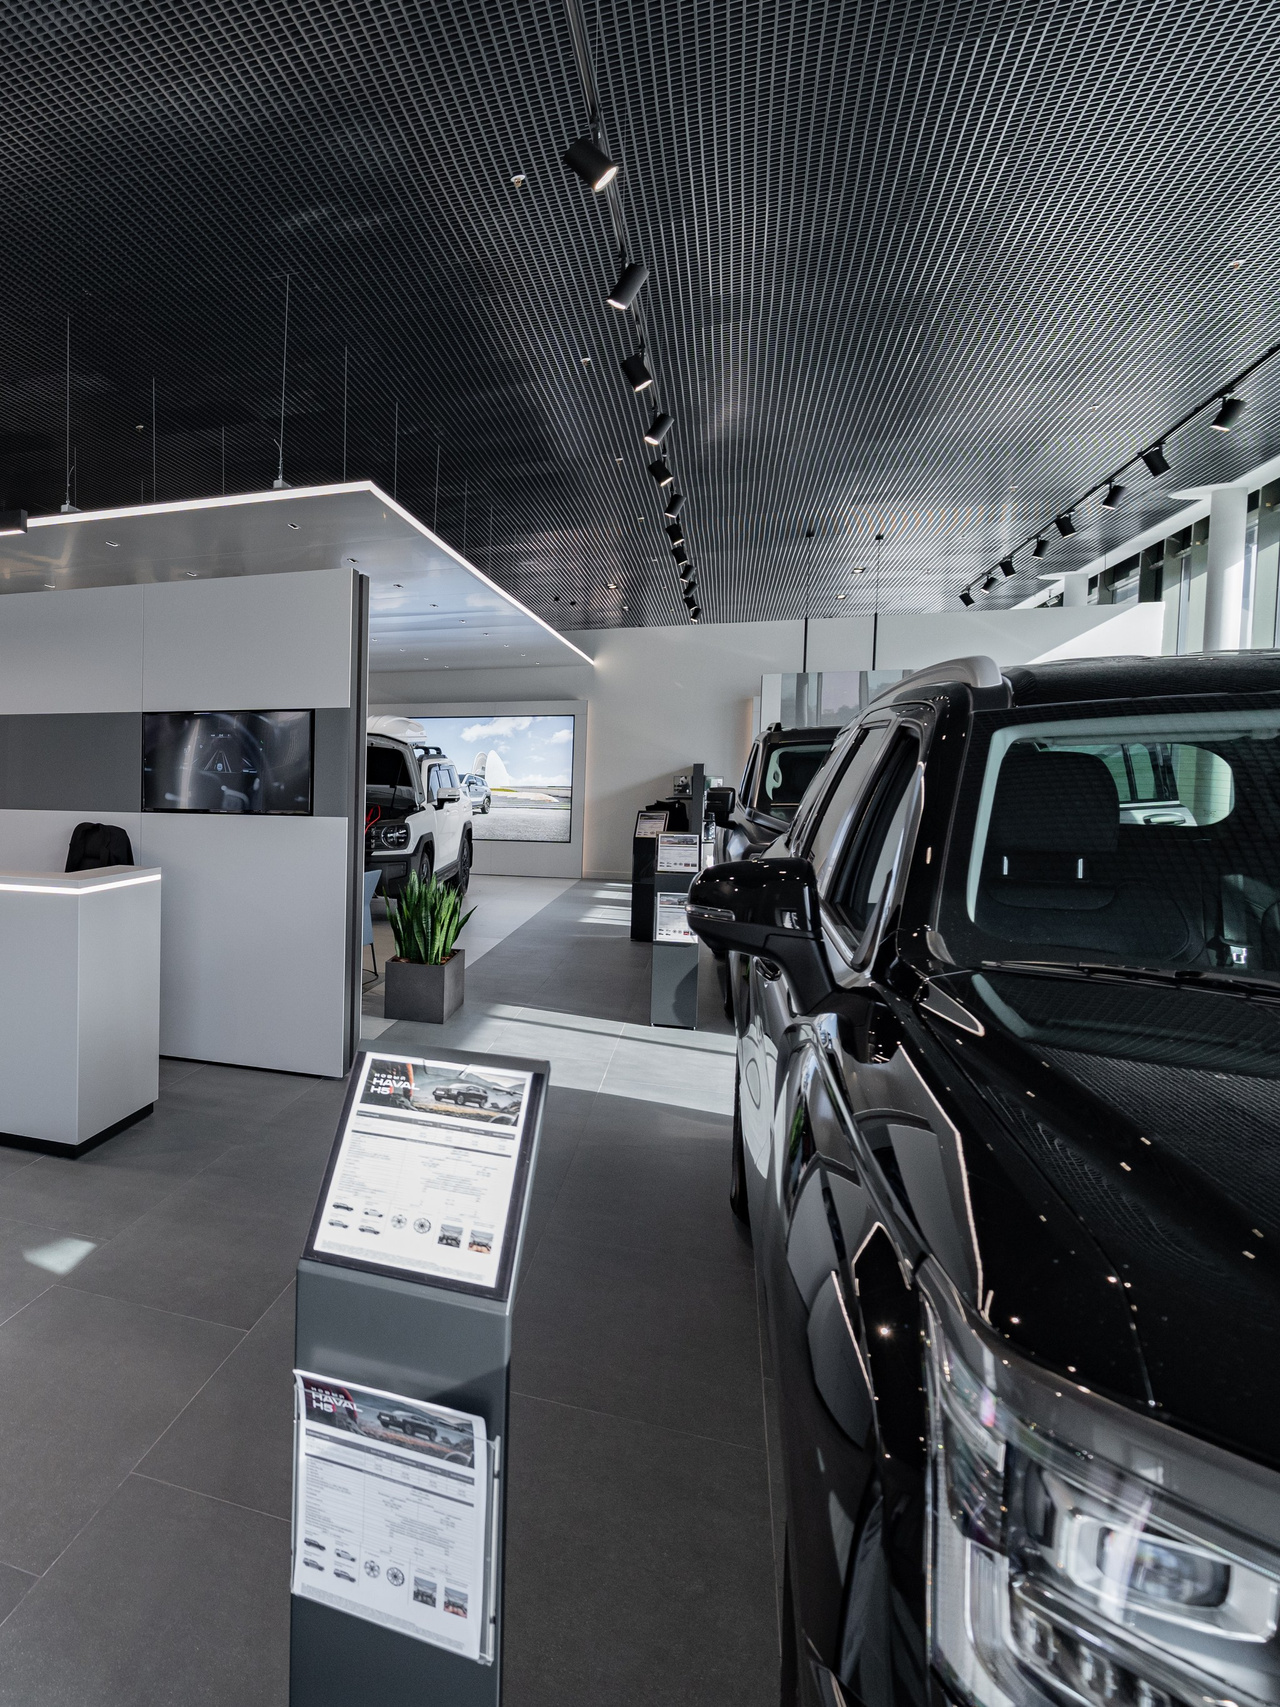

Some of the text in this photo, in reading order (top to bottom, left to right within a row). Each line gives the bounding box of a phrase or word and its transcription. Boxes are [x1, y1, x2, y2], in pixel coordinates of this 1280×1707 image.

[370, 1085, 391, 1095] H5
[372, 1077, 420, 1091] HAVAL
[312, 1391, 363, 1413] HAVAL
[312, 1399, 334, 1413] H5
